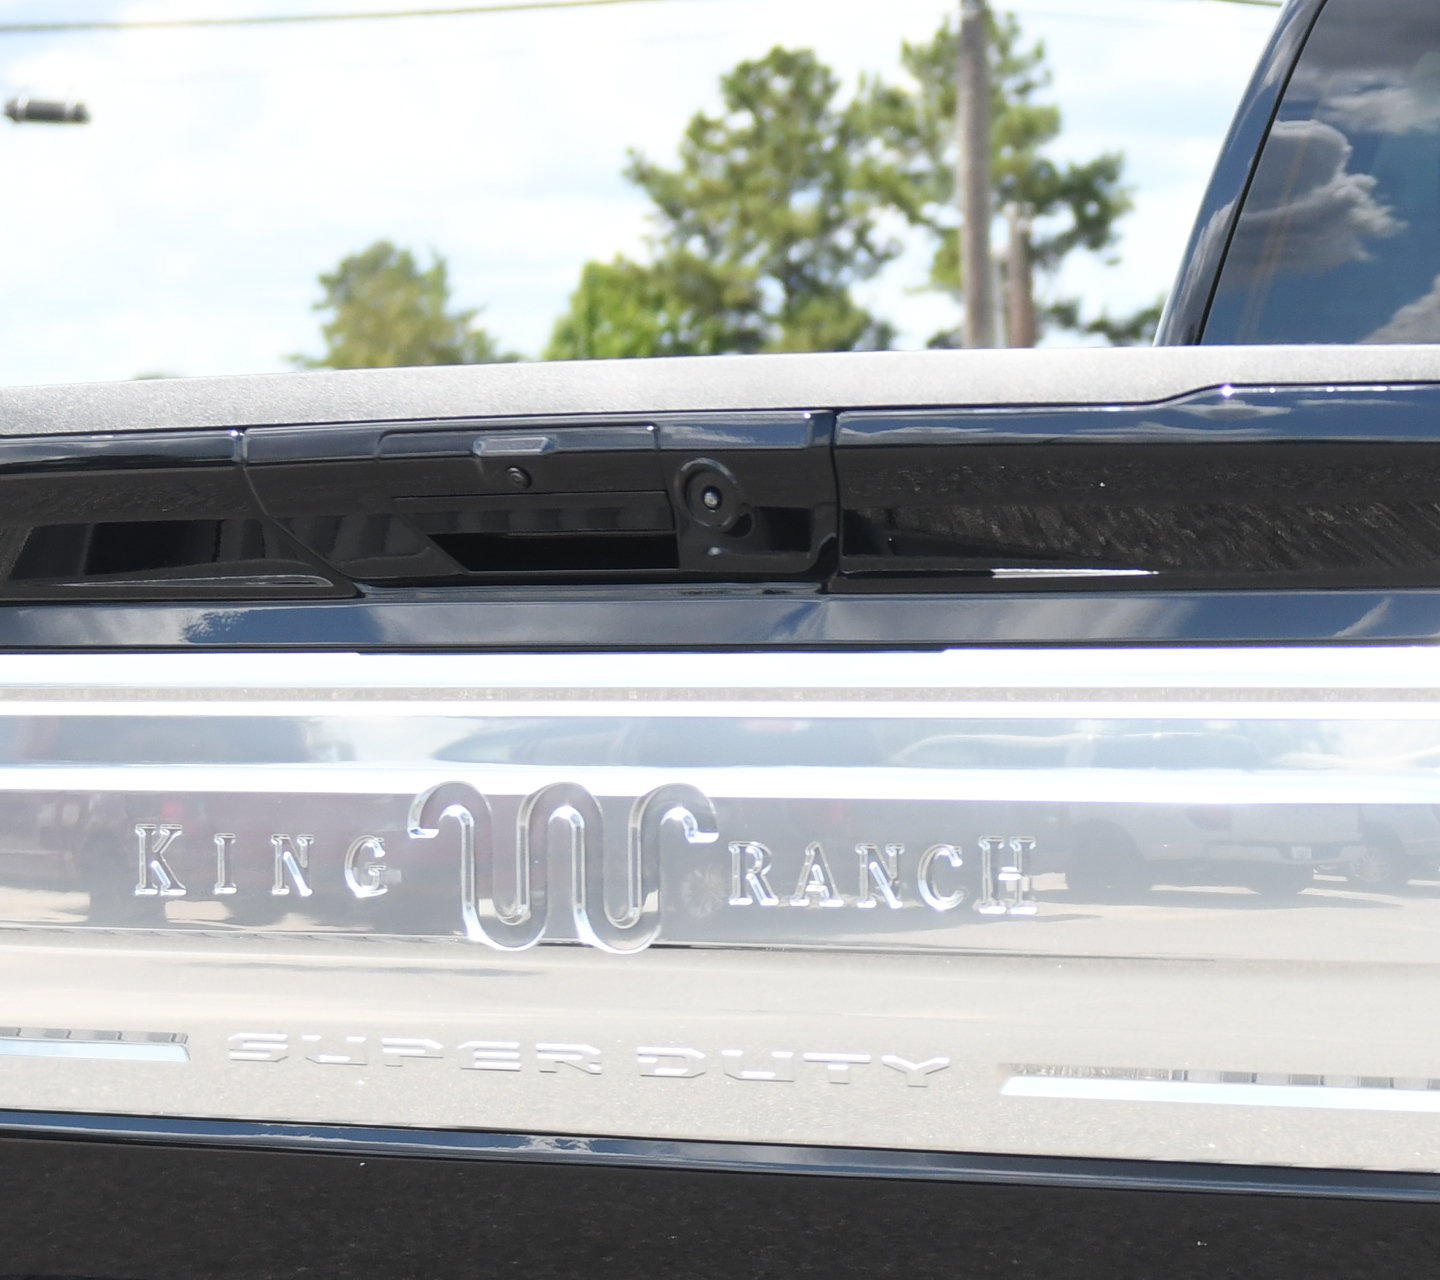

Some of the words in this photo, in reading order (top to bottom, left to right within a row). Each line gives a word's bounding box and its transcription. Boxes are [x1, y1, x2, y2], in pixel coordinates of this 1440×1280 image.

[134, 823, 388, 898] KING
[728, 834, 1038, 915] RANCH
[227, 1032, 603, 1076] SUPER
[635, 1045, 951, 1088] DUTY
